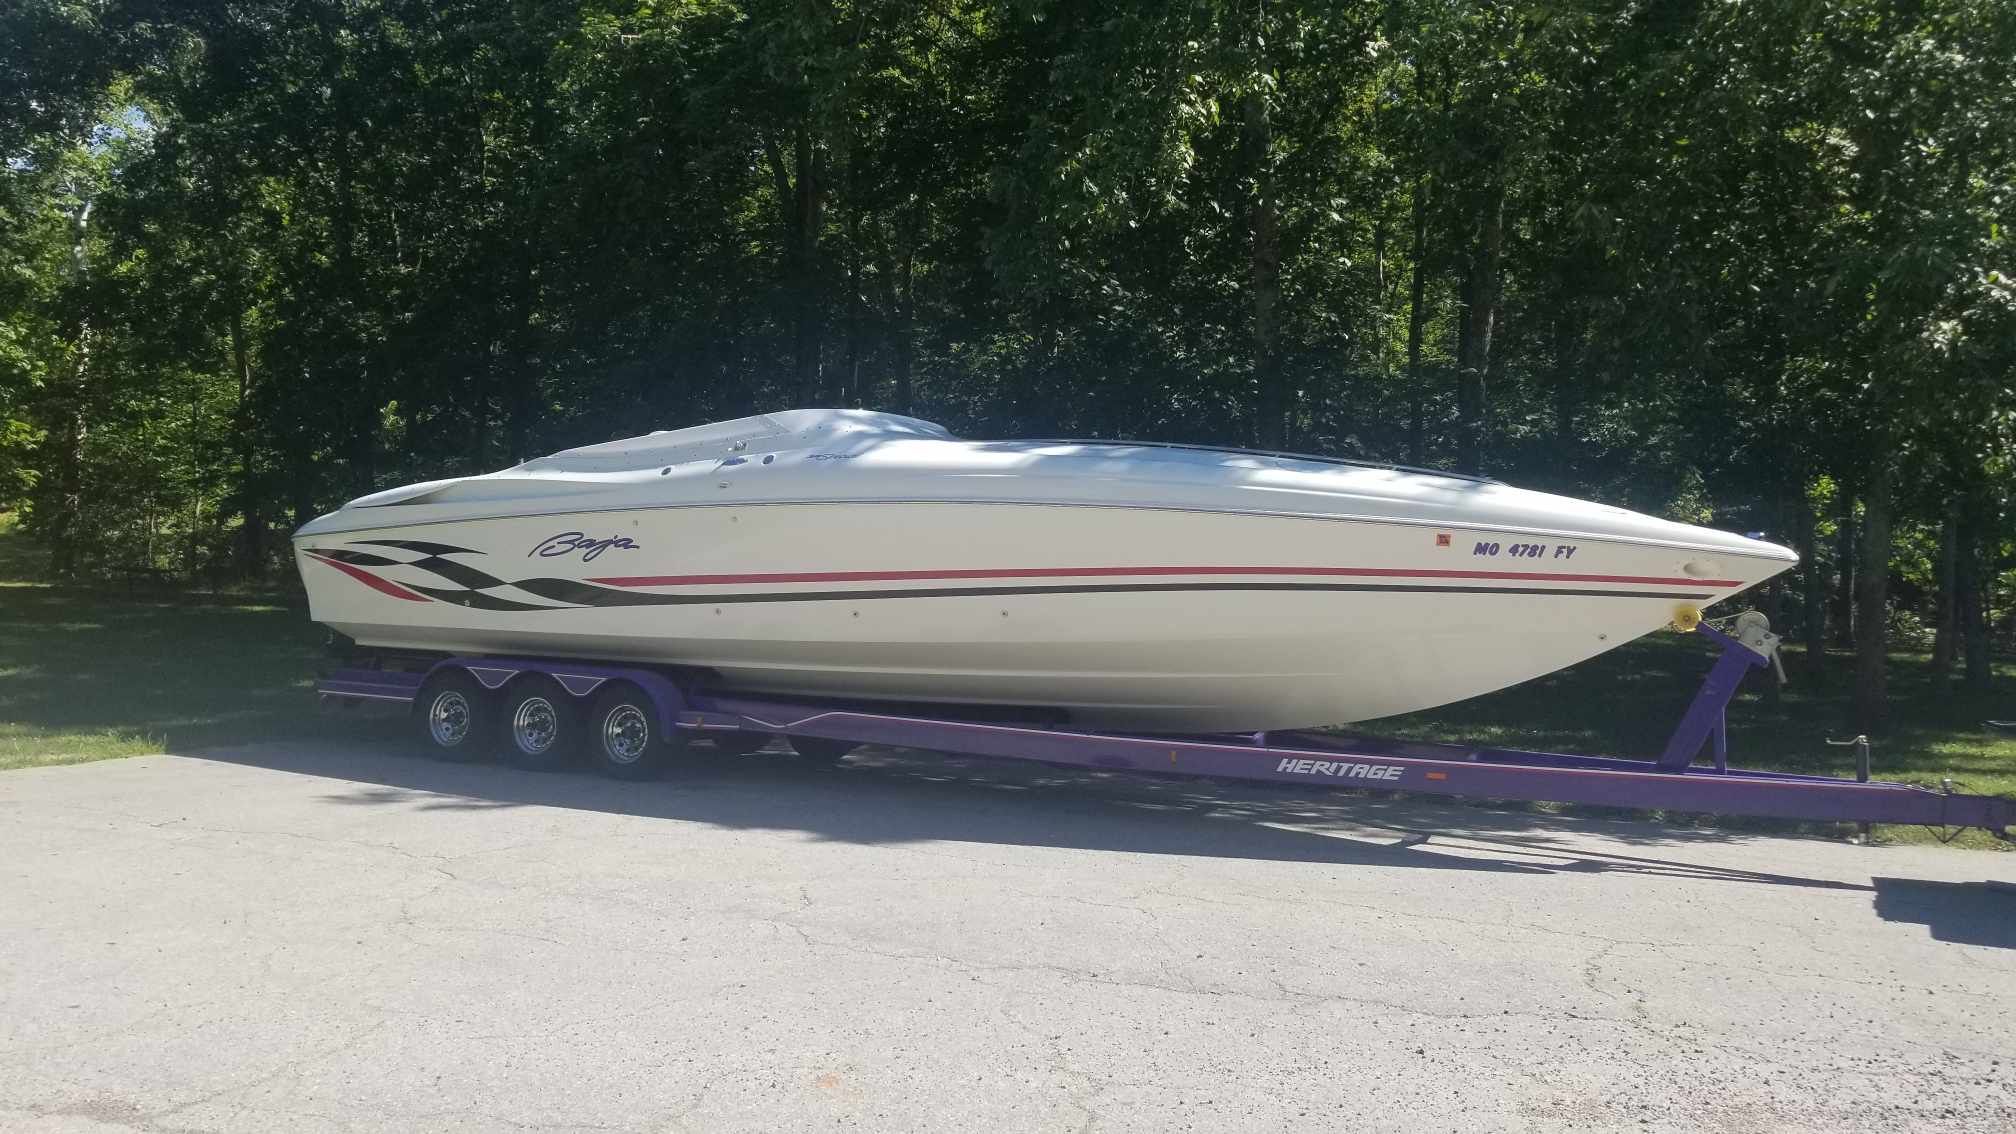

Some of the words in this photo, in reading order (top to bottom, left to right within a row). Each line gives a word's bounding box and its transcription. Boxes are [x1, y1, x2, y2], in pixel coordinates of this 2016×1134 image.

[527, 531, 641, 563] Baja
[1473, 542, 1500, 556] MO
[1508, 543, 1546, 558] 4781
[1554, 545, 1577, 559] FY
[1276, 758, 1405, 781] HERITAGE
